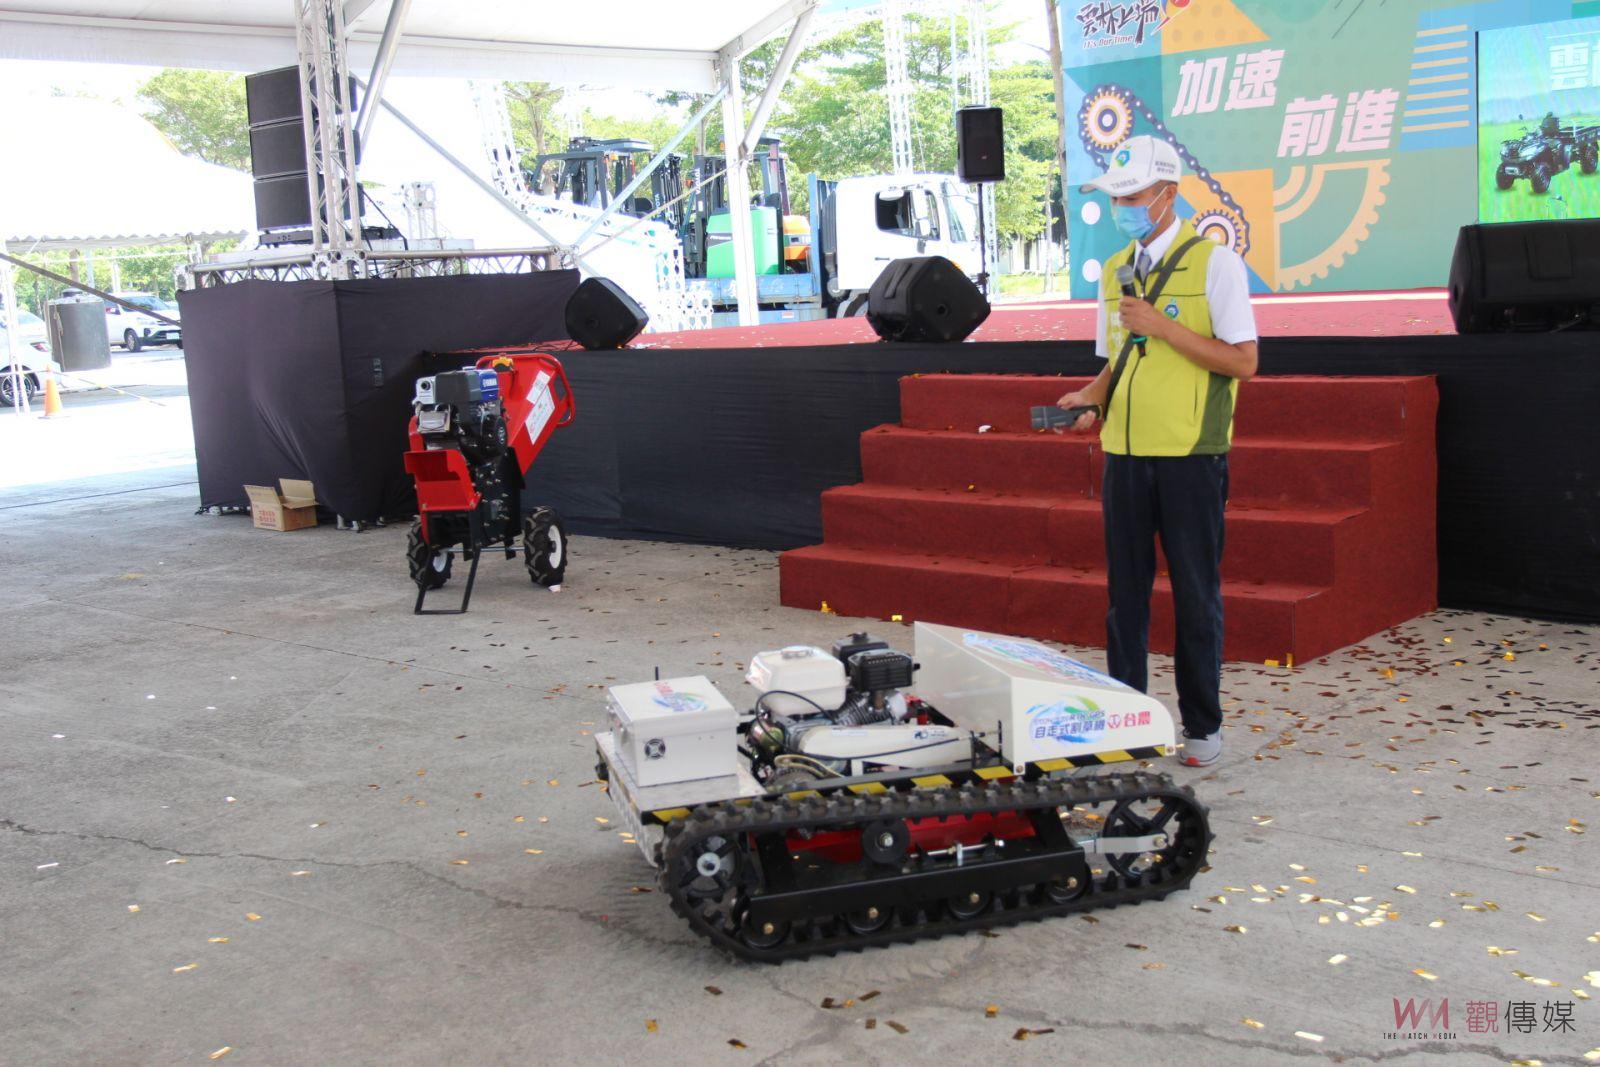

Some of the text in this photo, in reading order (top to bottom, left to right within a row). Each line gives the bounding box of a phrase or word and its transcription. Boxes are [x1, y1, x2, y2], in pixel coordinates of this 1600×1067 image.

[1170, 49, 1285, 117] 加速
[1277, 88, 1401, 158] 前進
[1123, 711, 1151, 728] 台農
